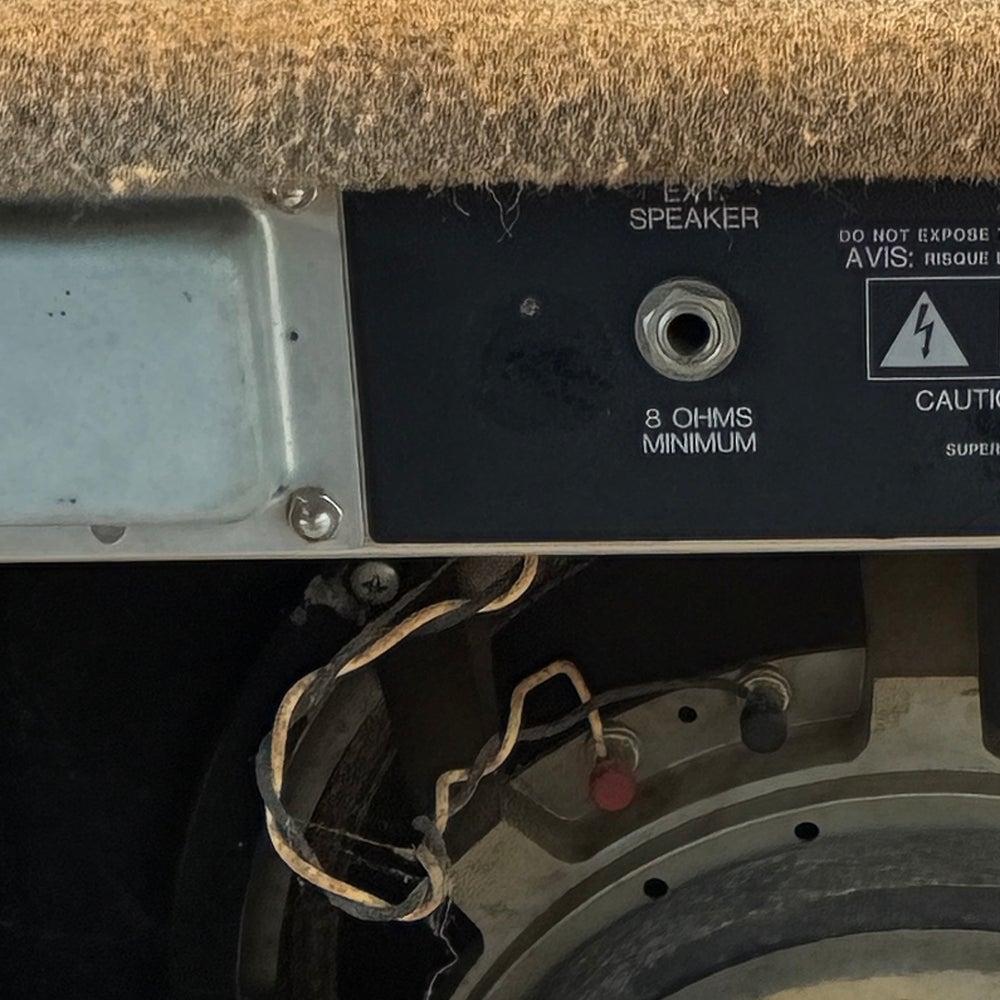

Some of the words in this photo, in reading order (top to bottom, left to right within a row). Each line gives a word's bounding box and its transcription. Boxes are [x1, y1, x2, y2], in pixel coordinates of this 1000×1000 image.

[630, 207, 759, 230] SPEAKER
[839, 229, 865, 243] DO
[873, 228, 910, 243] NOT
[918, 227, 990, 242] EXPOSE
[845, 246, 914, 269] AVIS:
[924, 251, 989, 267] RISQUE
[645, 408, 661, 429] 8
[672, 406, 753, 429] OHMS
[643, 432, 757, 454] MINIMUM
